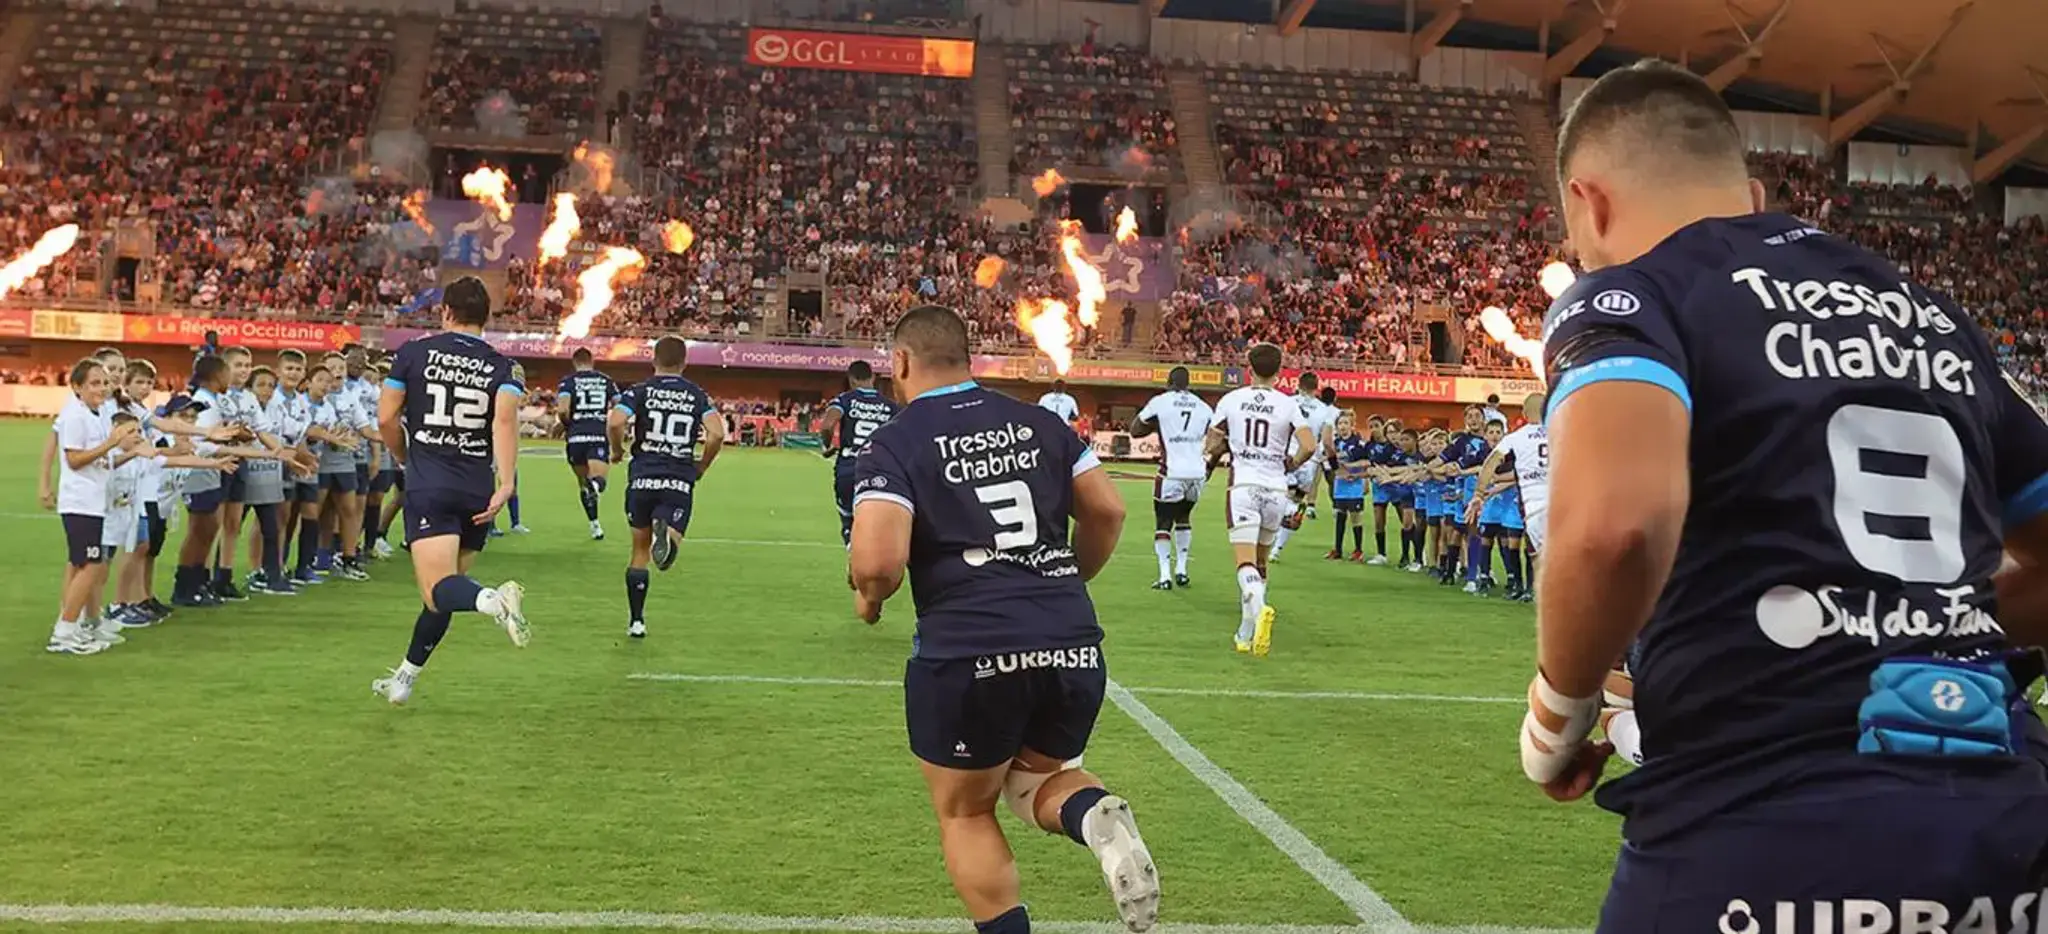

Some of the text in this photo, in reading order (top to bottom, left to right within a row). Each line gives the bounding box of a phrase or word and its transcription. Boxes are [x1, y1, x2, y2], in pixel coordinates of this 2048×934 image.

[792, 38, 853, 65] GGL
[1732, 268, 1928, 329] Tressol
[157, 319, 325, 341] La Région Occitanie
[428, 349, 484, 371] Tressol
[424, 365, 493, 388] Chabrier
[1364, 376, 1450, 397] HÉRAULT
[423, 383, 490, 429] 12
[576, 391, 607, 409] 13
[645, 410, 694, 444] 10
[1181, 410, 1191, 432] 7
[1245, 417, 1270, 448] 10
[934, 421, 1017, 460] Tressol
[944, 446, 1041, 484] Chabrier
[1827, 403, 1967, 584] 8
[974, 479, 1038, 550] 3
[87, 546, 100, 558] 10
[1817, 584, 1880, 647] Sud
[1882, 598, 1944, 637] de
[995, 646, 1099, 673] URBASER
